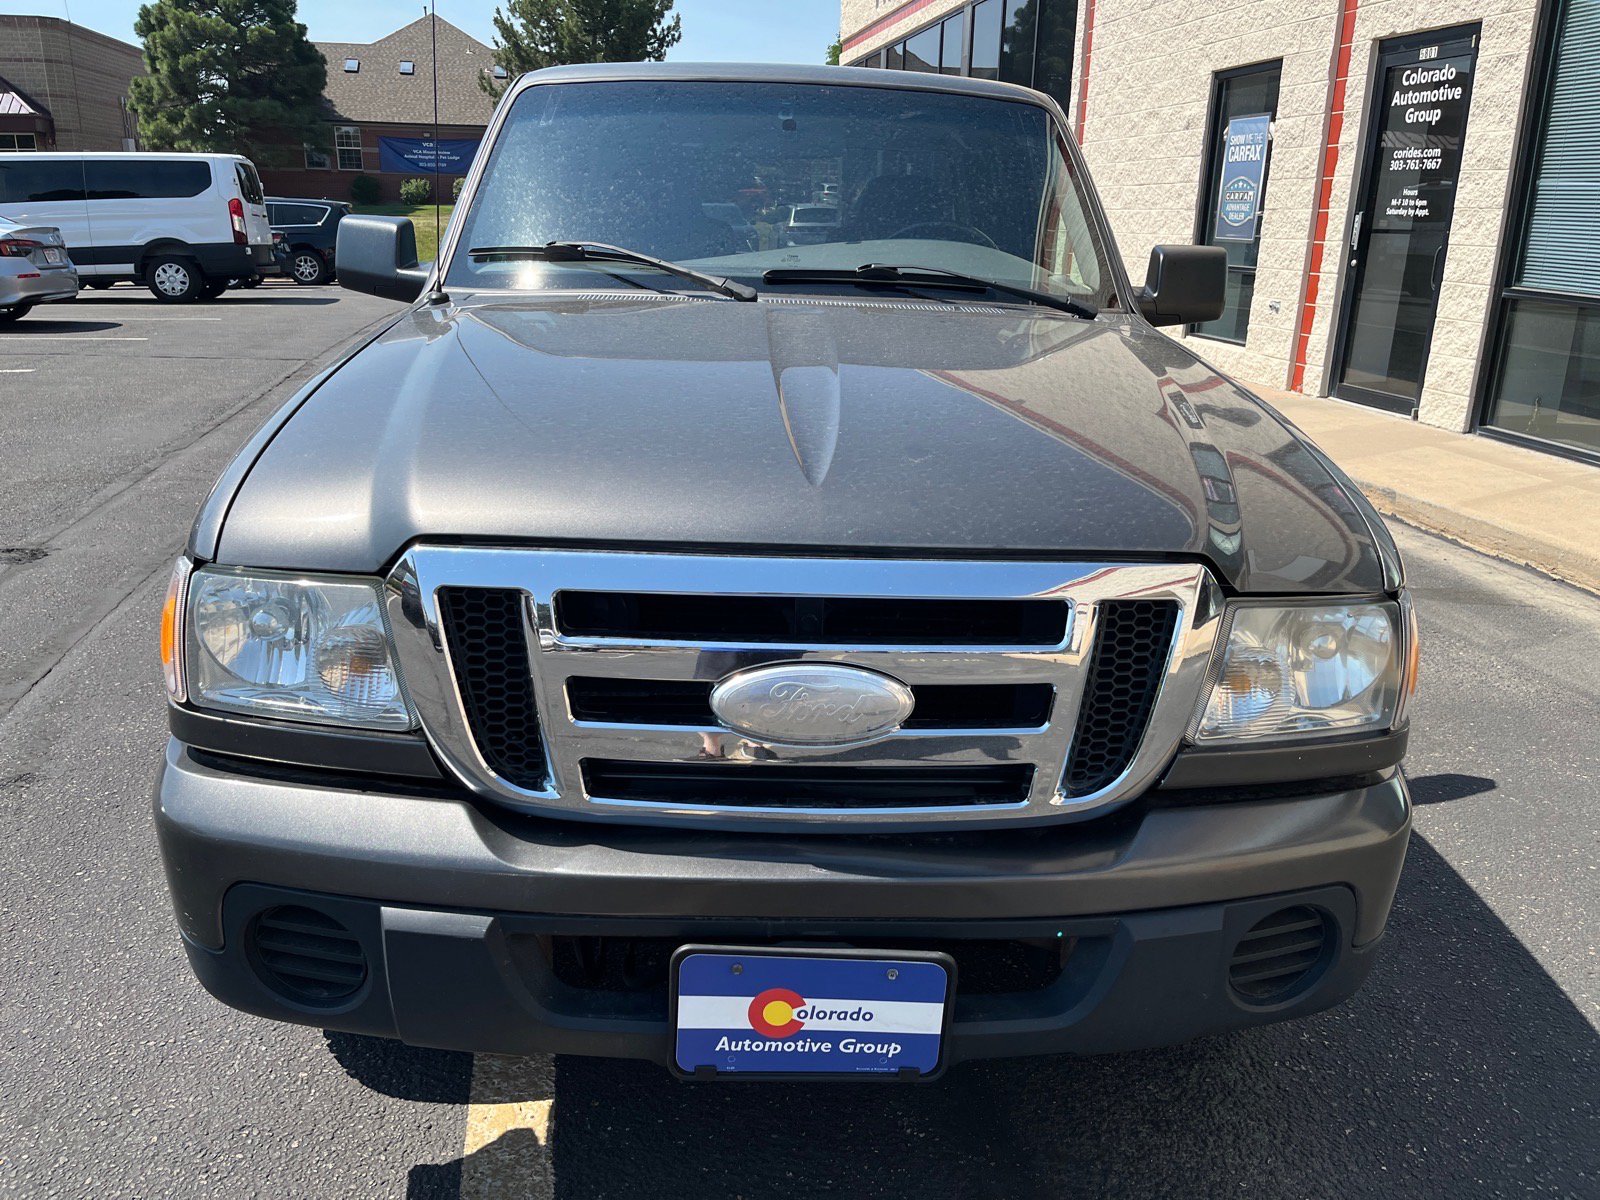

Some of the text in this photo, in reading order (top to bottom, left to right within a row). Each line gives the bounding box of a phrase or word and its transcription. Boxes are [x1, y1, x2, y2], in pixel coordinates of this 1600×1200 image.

[1420, 47, 1437, 59] 5801
[1402, 63, 1456, 86] Colorado
[1391, 84, 1462, 107] Automotive
[1405, 107, 1441, 126] Group
[1230, 134, 1246, 145] SHOW
[1228, 144, 1264, 162] CARFAX
[1393, 146, 1441, 159] corides.com
[1389, 158, 1442, 171] 303-761-7667
[1403, 188, 1418, 196] Hours
[1226, 203, 1250, 211] ADVANTAGE
[1391, 198, 1401, 206] M-F
[1402, 198, 1408, 206] 10
[1385, 207, 1429, 217] Saturday by Appt.
[759, 681, 868, 723] Ford
[715, 1036, 902, 1058] Automotive Group
